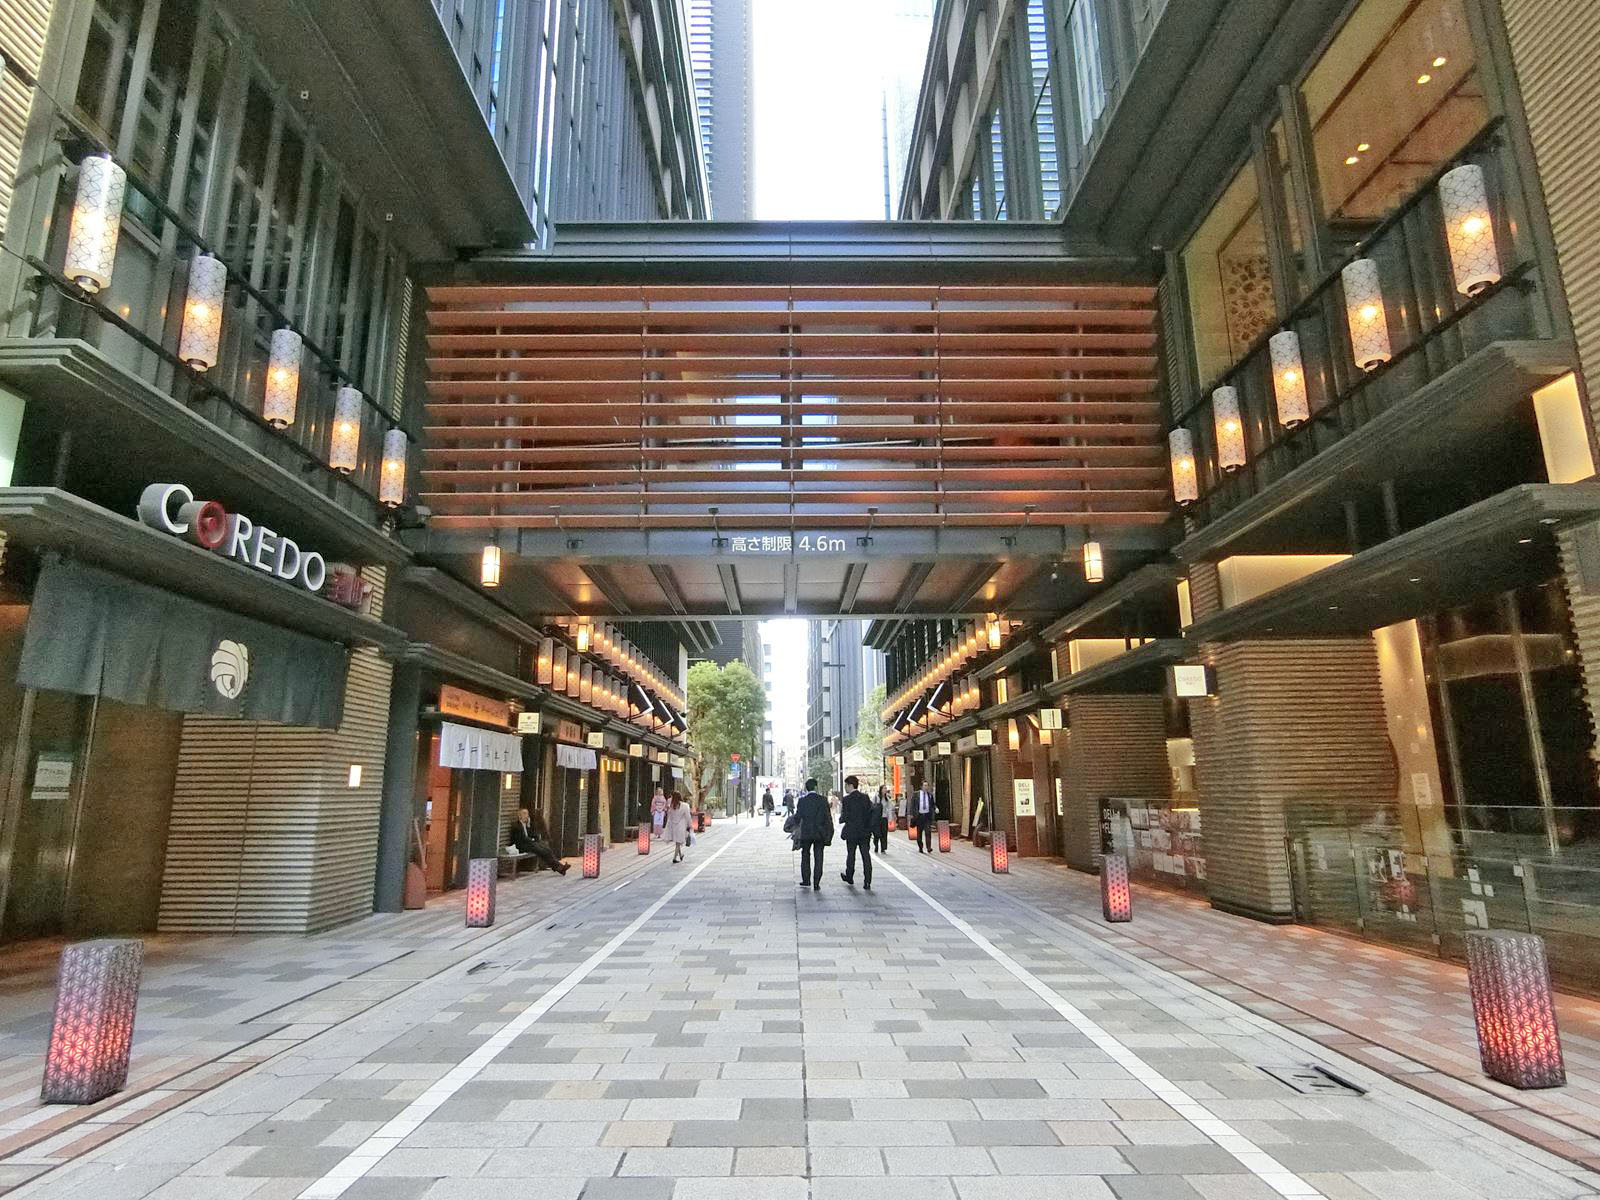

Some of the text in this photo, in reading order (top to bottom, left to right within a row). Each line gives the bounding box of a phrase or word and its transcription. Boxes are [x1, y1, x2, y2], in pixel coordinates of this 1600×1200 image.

[158, 483, 326, 592] COREDO
[731, 535, 847, 552] 高さ制限 4.6m
